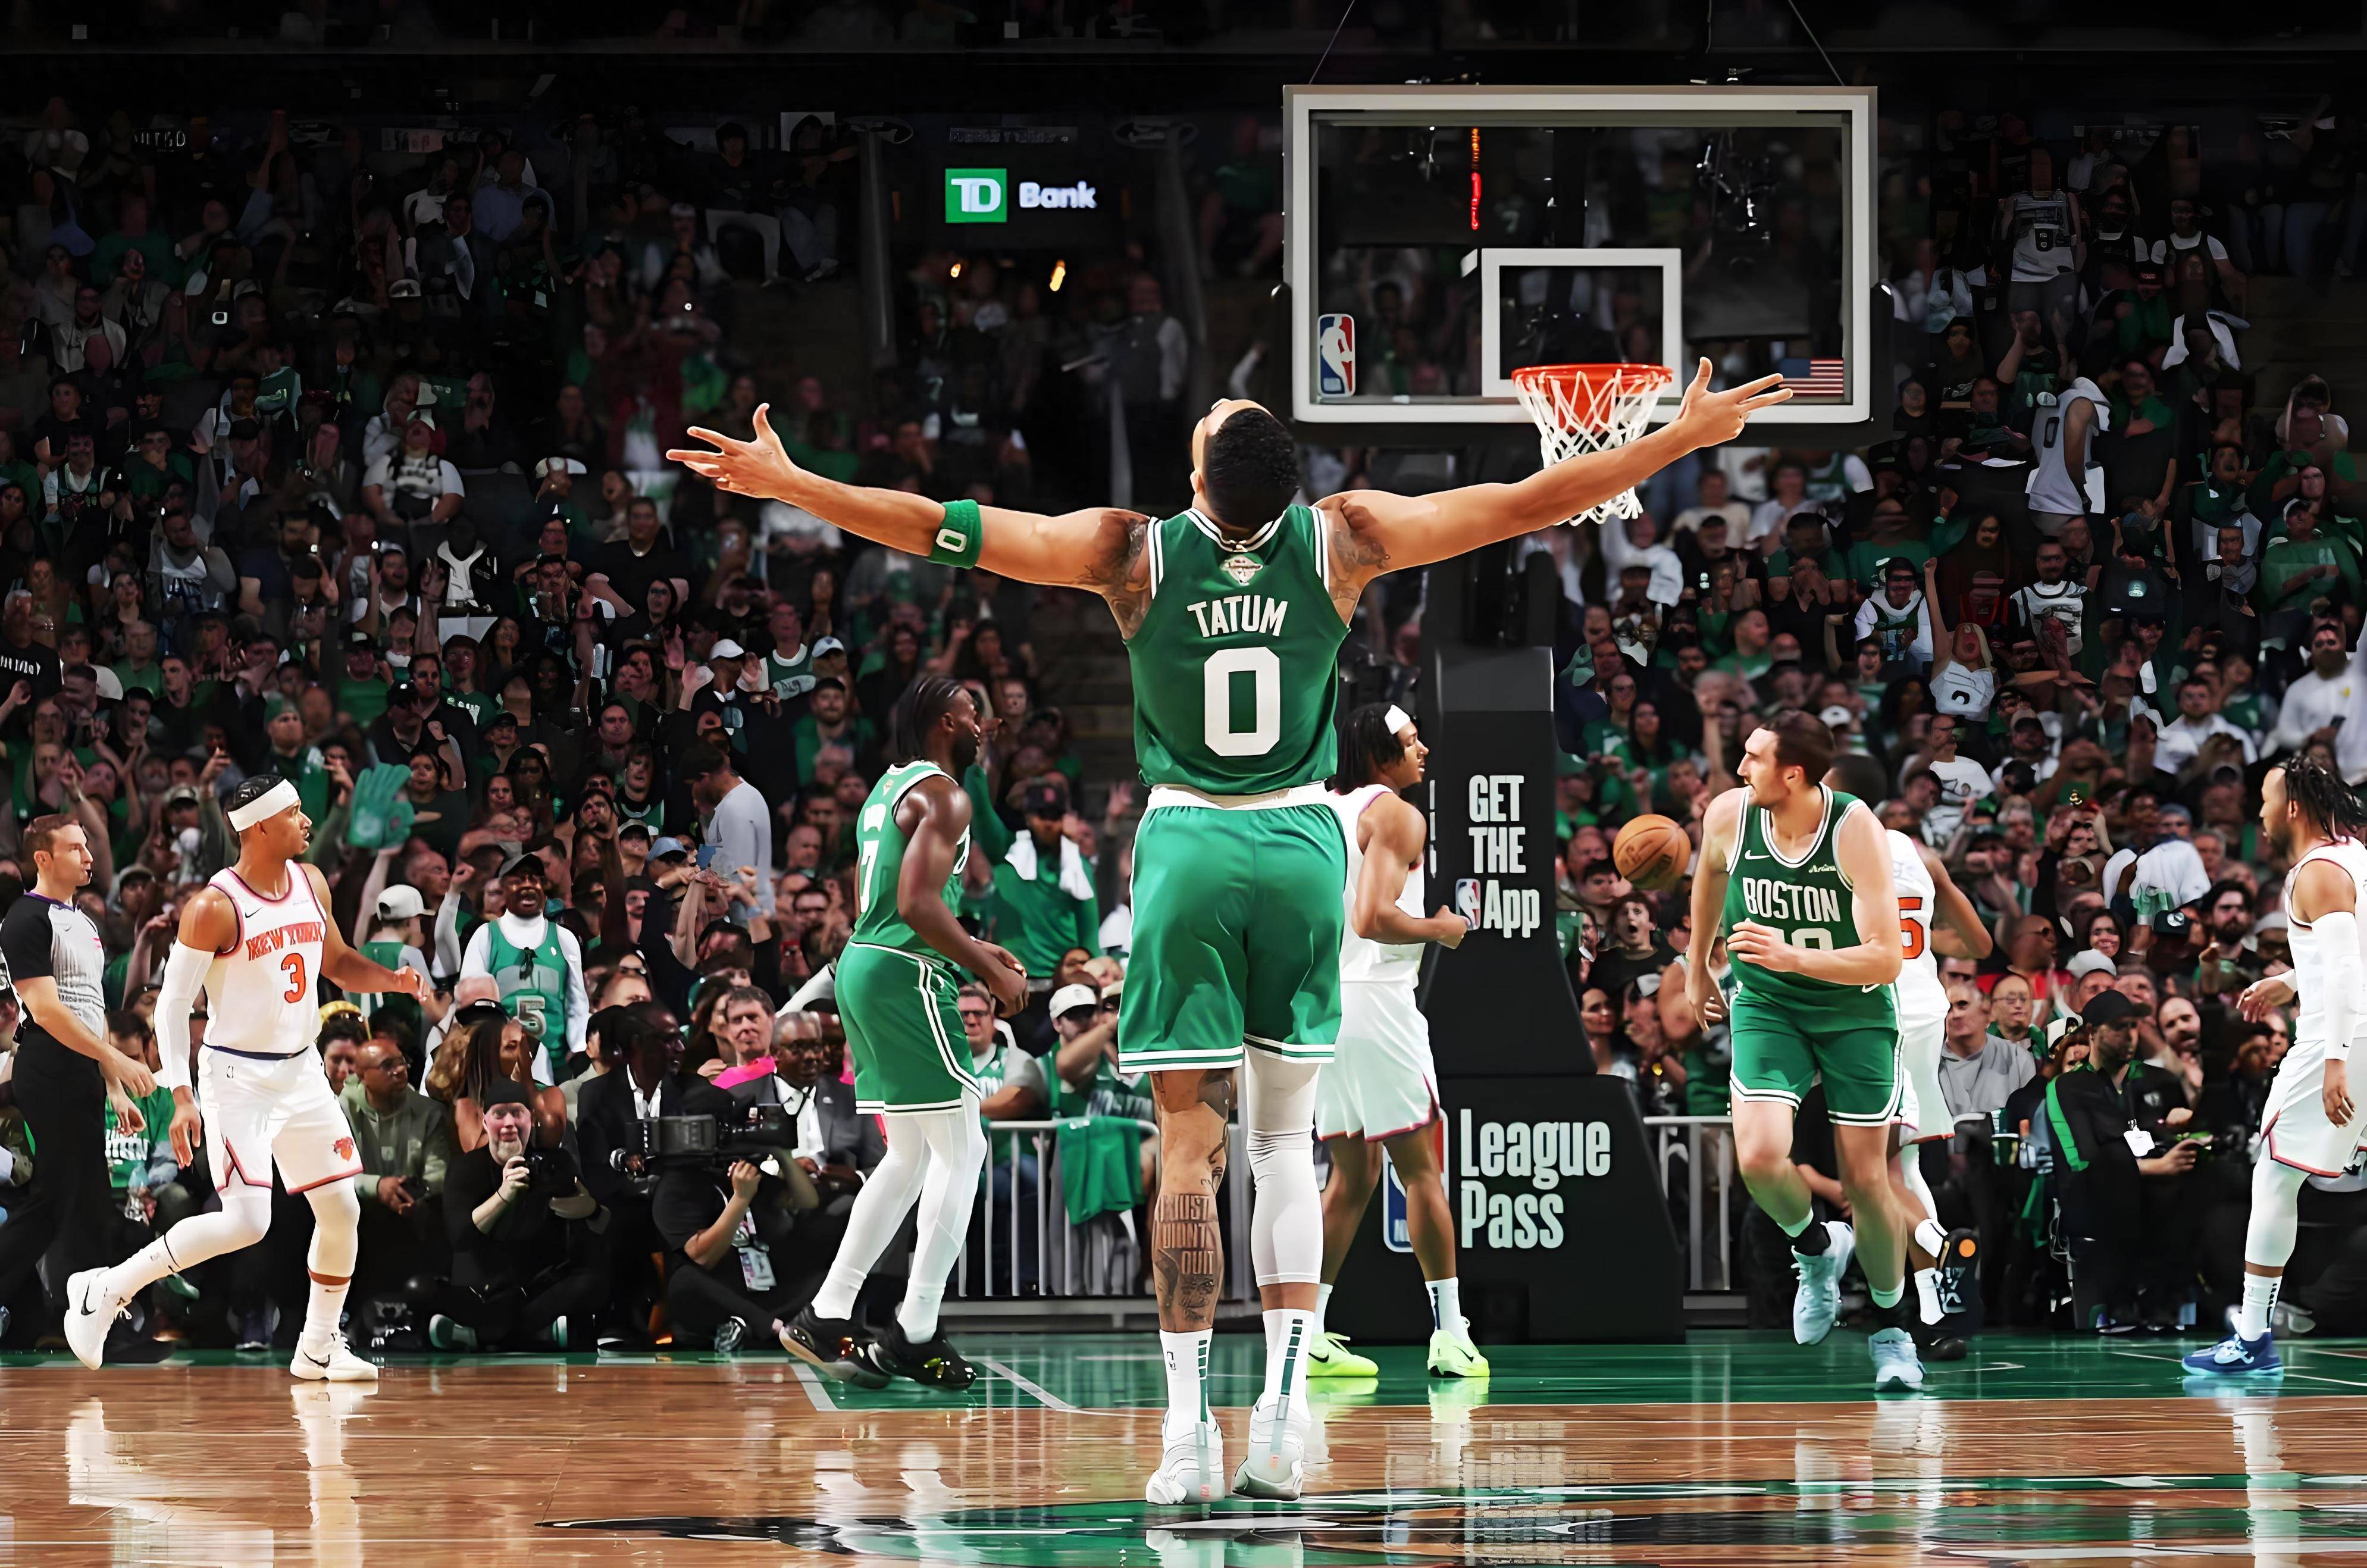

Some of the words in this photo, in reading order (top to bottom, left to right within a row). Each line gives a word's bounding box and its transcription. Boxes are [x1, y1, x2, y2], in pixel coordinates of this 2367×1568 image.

[951, 177, 1001, 213] TD
[1018, 180, 1098, 209] Bank
[2043, 417, 2059, 448] 0
[936, 528, 968, 552] 0
[1187, 595, 1288, 638] TATUM
[1204, 646, 1280, 756] 0
[1469, 775, 1524, 822] GET
[1469, 827, 1526, 874] THE
[1483, 880, 1540, 938] App
[1742, 877, 1841, 922] BOSTON
[281, 953, 306, 1003] 3
[516, 995, 547, 1038] 5
[1460, 1109, 1611, 1190] League
[1461, 1180, 1564, 1249] Pass
